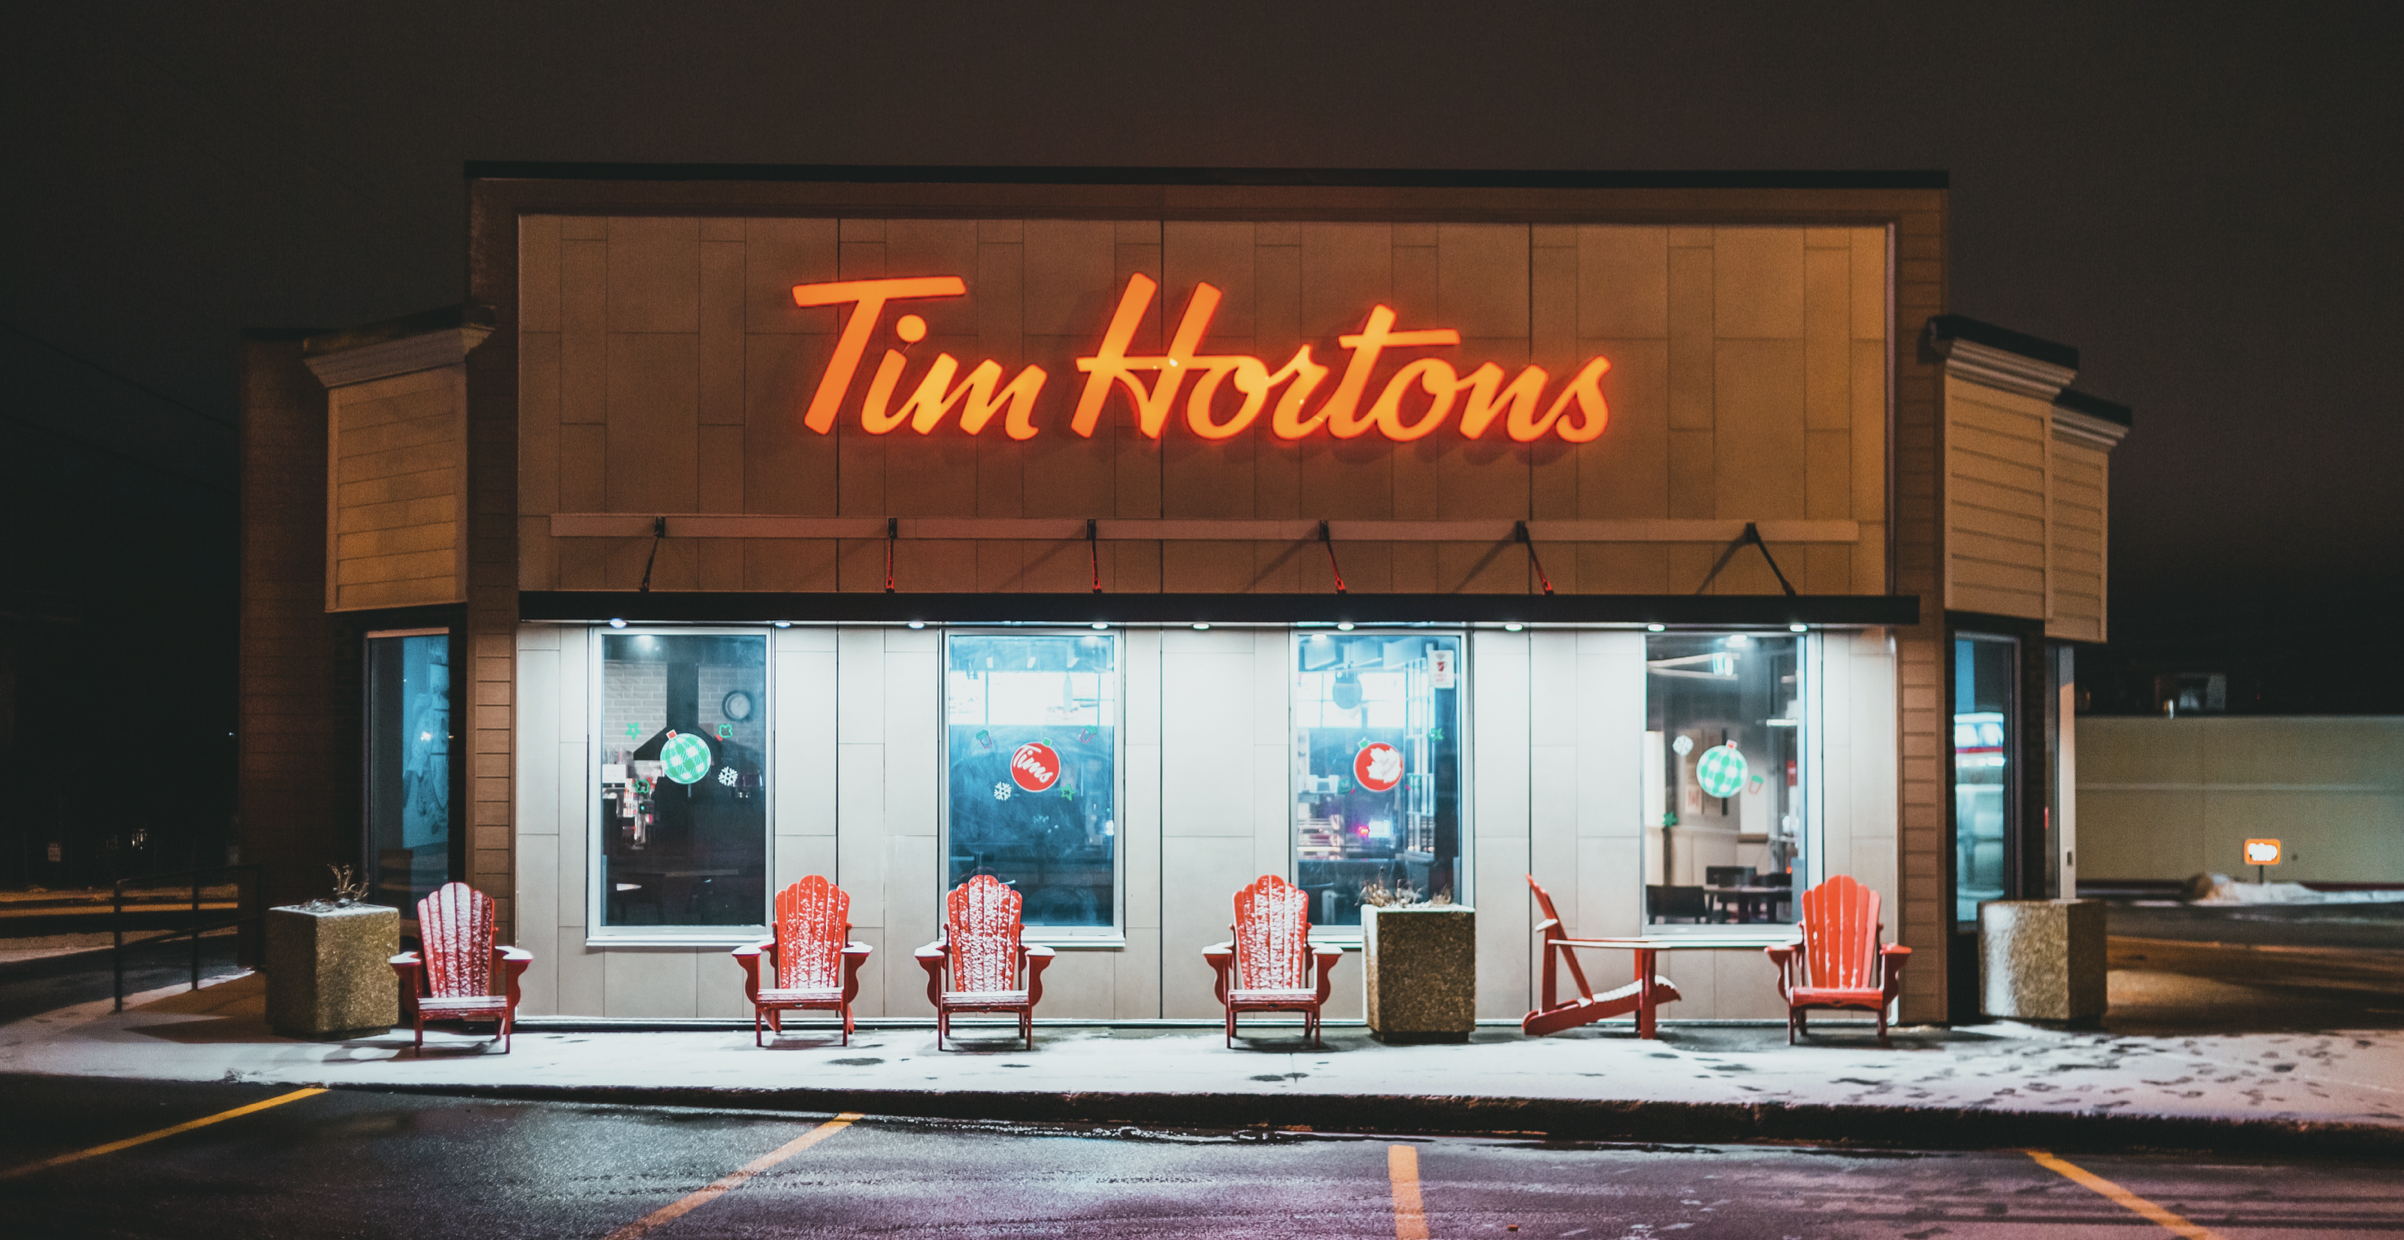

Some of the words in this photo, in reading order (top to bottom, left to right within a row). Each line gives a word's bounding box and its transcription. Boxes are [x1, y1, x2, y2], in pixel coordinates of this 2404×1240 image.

[792, 276, 1047, 440] Tim
[1071, 272, 1611, 442] Hortons
[1013, 744, 1053, 783] Tims
